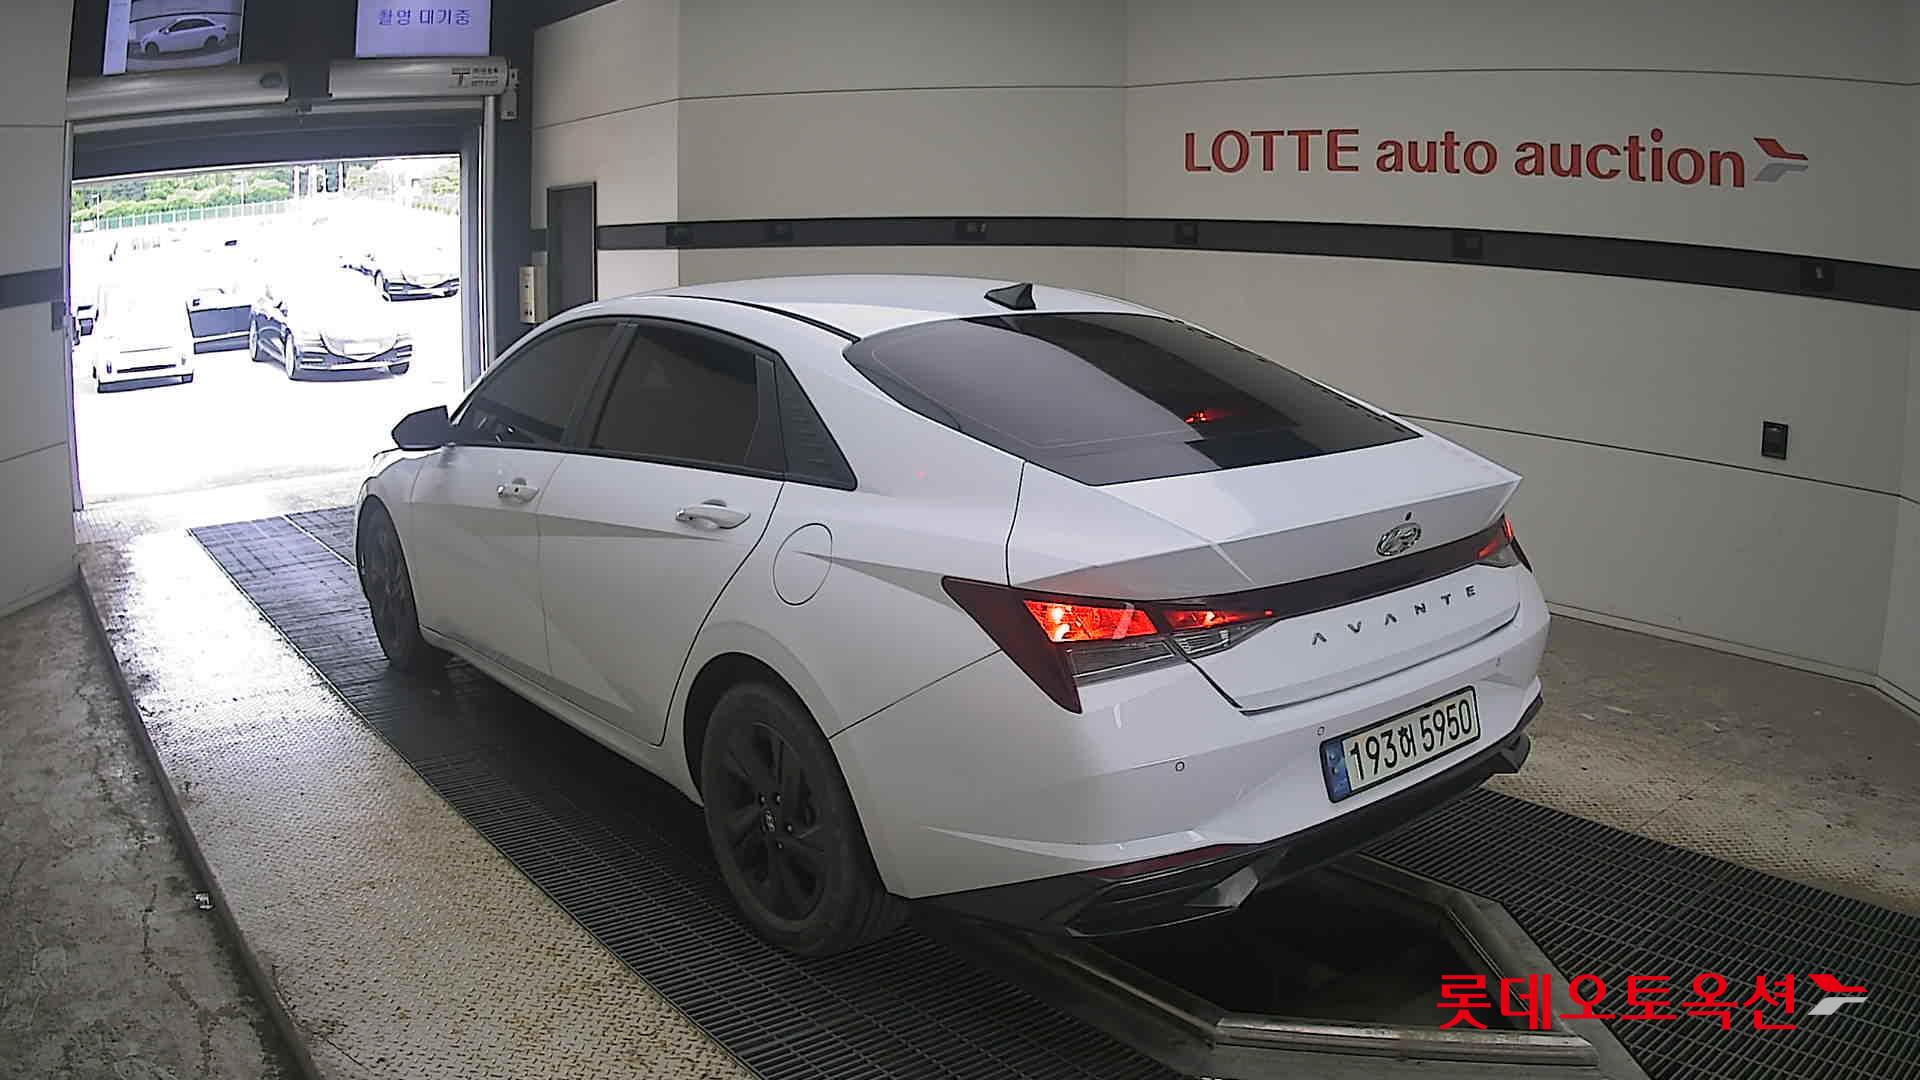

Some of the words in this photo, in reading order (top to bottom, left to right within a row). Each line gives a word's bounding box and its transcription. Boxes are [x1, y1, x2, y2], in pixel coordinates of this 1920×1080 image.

[419, 8, 471, 25] 대기중
[1184, 128, 1360, 172] LOTTE
[1376, 130, 1498, 176] auto
[1514, 128, 1746, 188] auction
[1311, 584, 1476, 646] AVANTE
[1419, 699, 1472, 752] 5950
